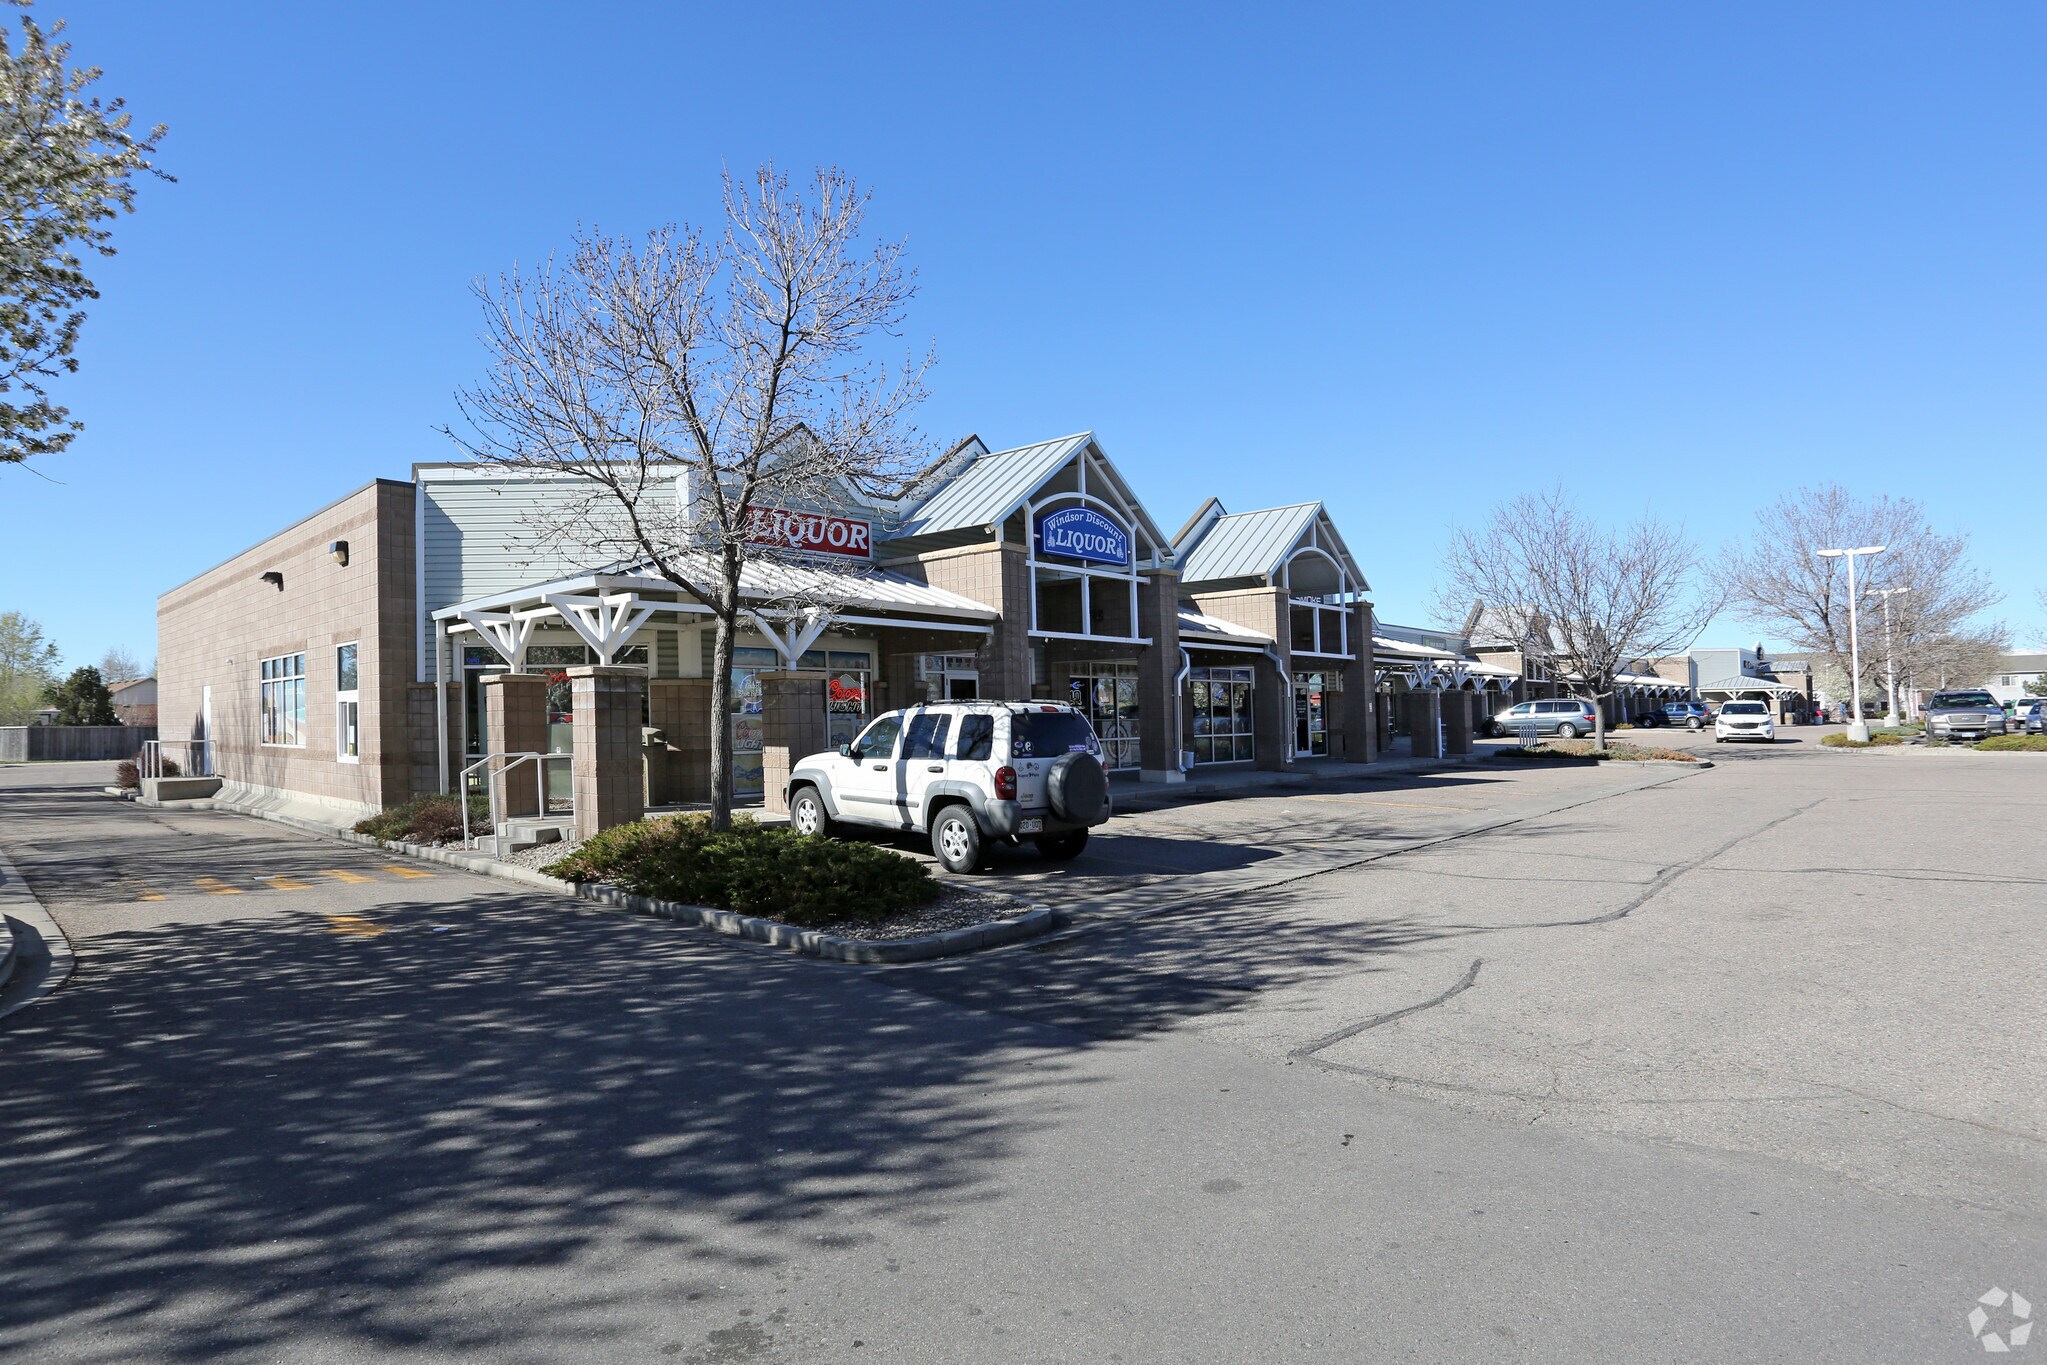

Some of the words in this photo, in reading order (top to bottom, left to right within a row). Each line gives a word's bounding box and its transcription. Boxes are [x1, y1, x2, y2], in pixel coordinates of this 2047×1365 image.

[749, 509, 868, 550] LIQUOR
[1047, 512, 1084, 531] Windsor
[1086, 512, 1123, 543] Discount
[1055, 528, 1117, 554] LIQUOR
